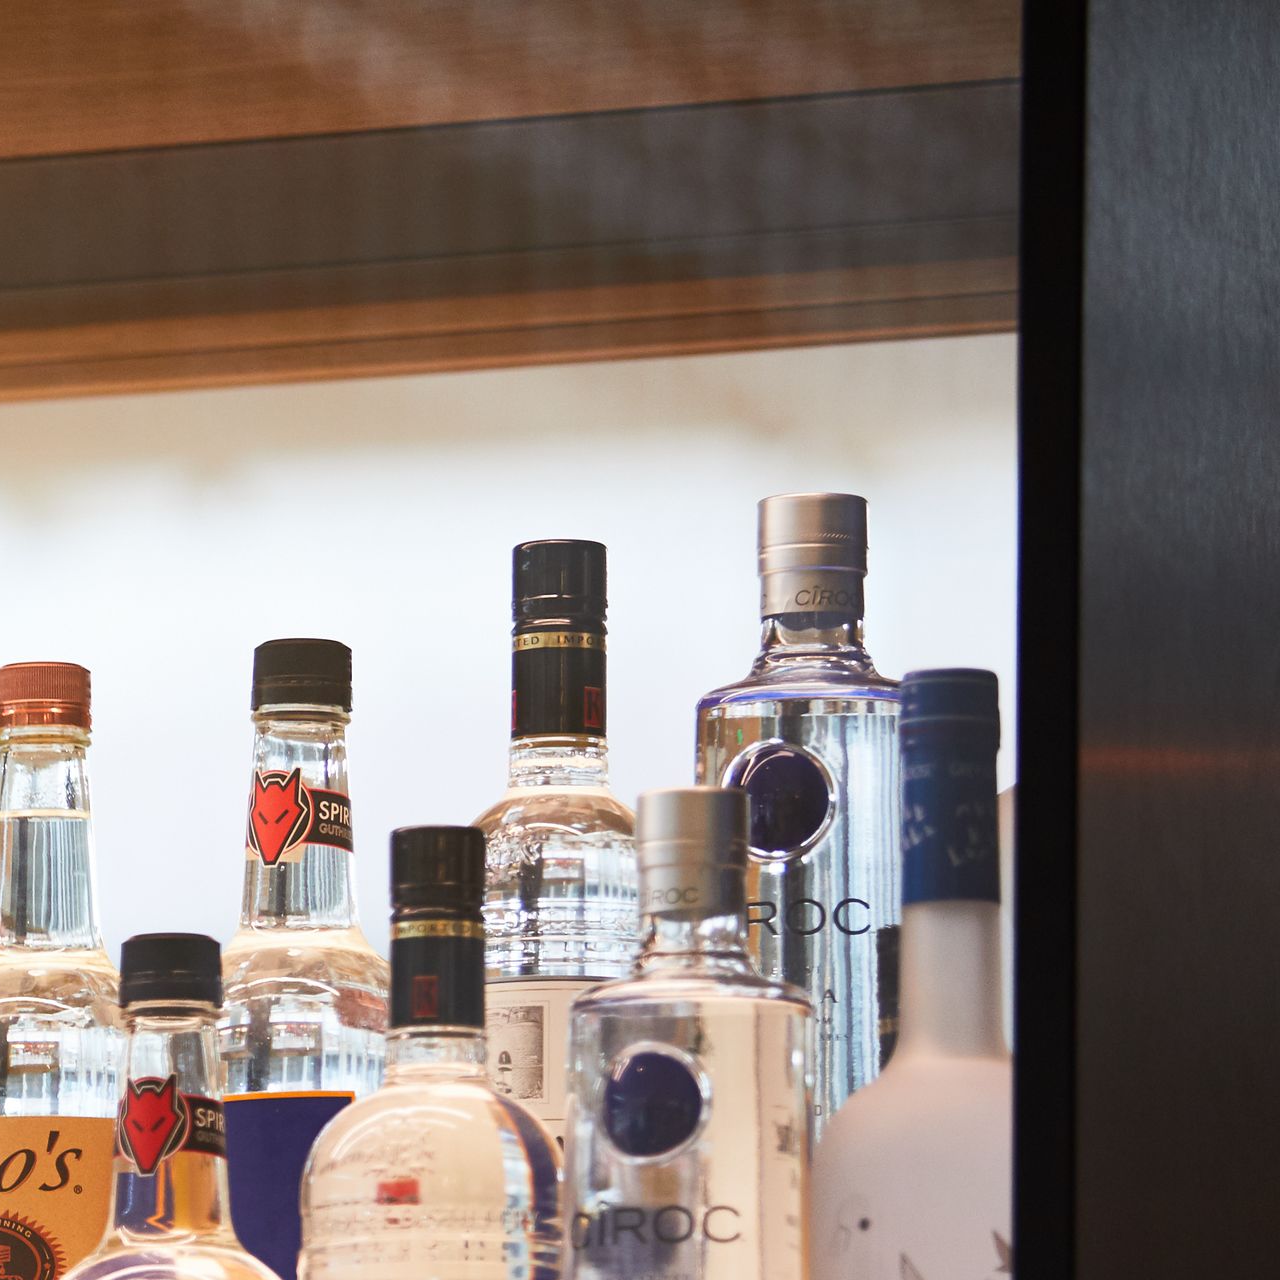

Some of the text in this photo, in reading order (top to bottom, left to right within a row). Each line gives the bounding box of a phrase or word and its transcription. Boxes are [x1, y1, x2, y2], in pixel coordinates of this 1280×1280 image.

[318, 800, 352, 827] SPIR
[747, 898, 872, 937] ROC
[195, 1107, 225, 1133] SPIR
